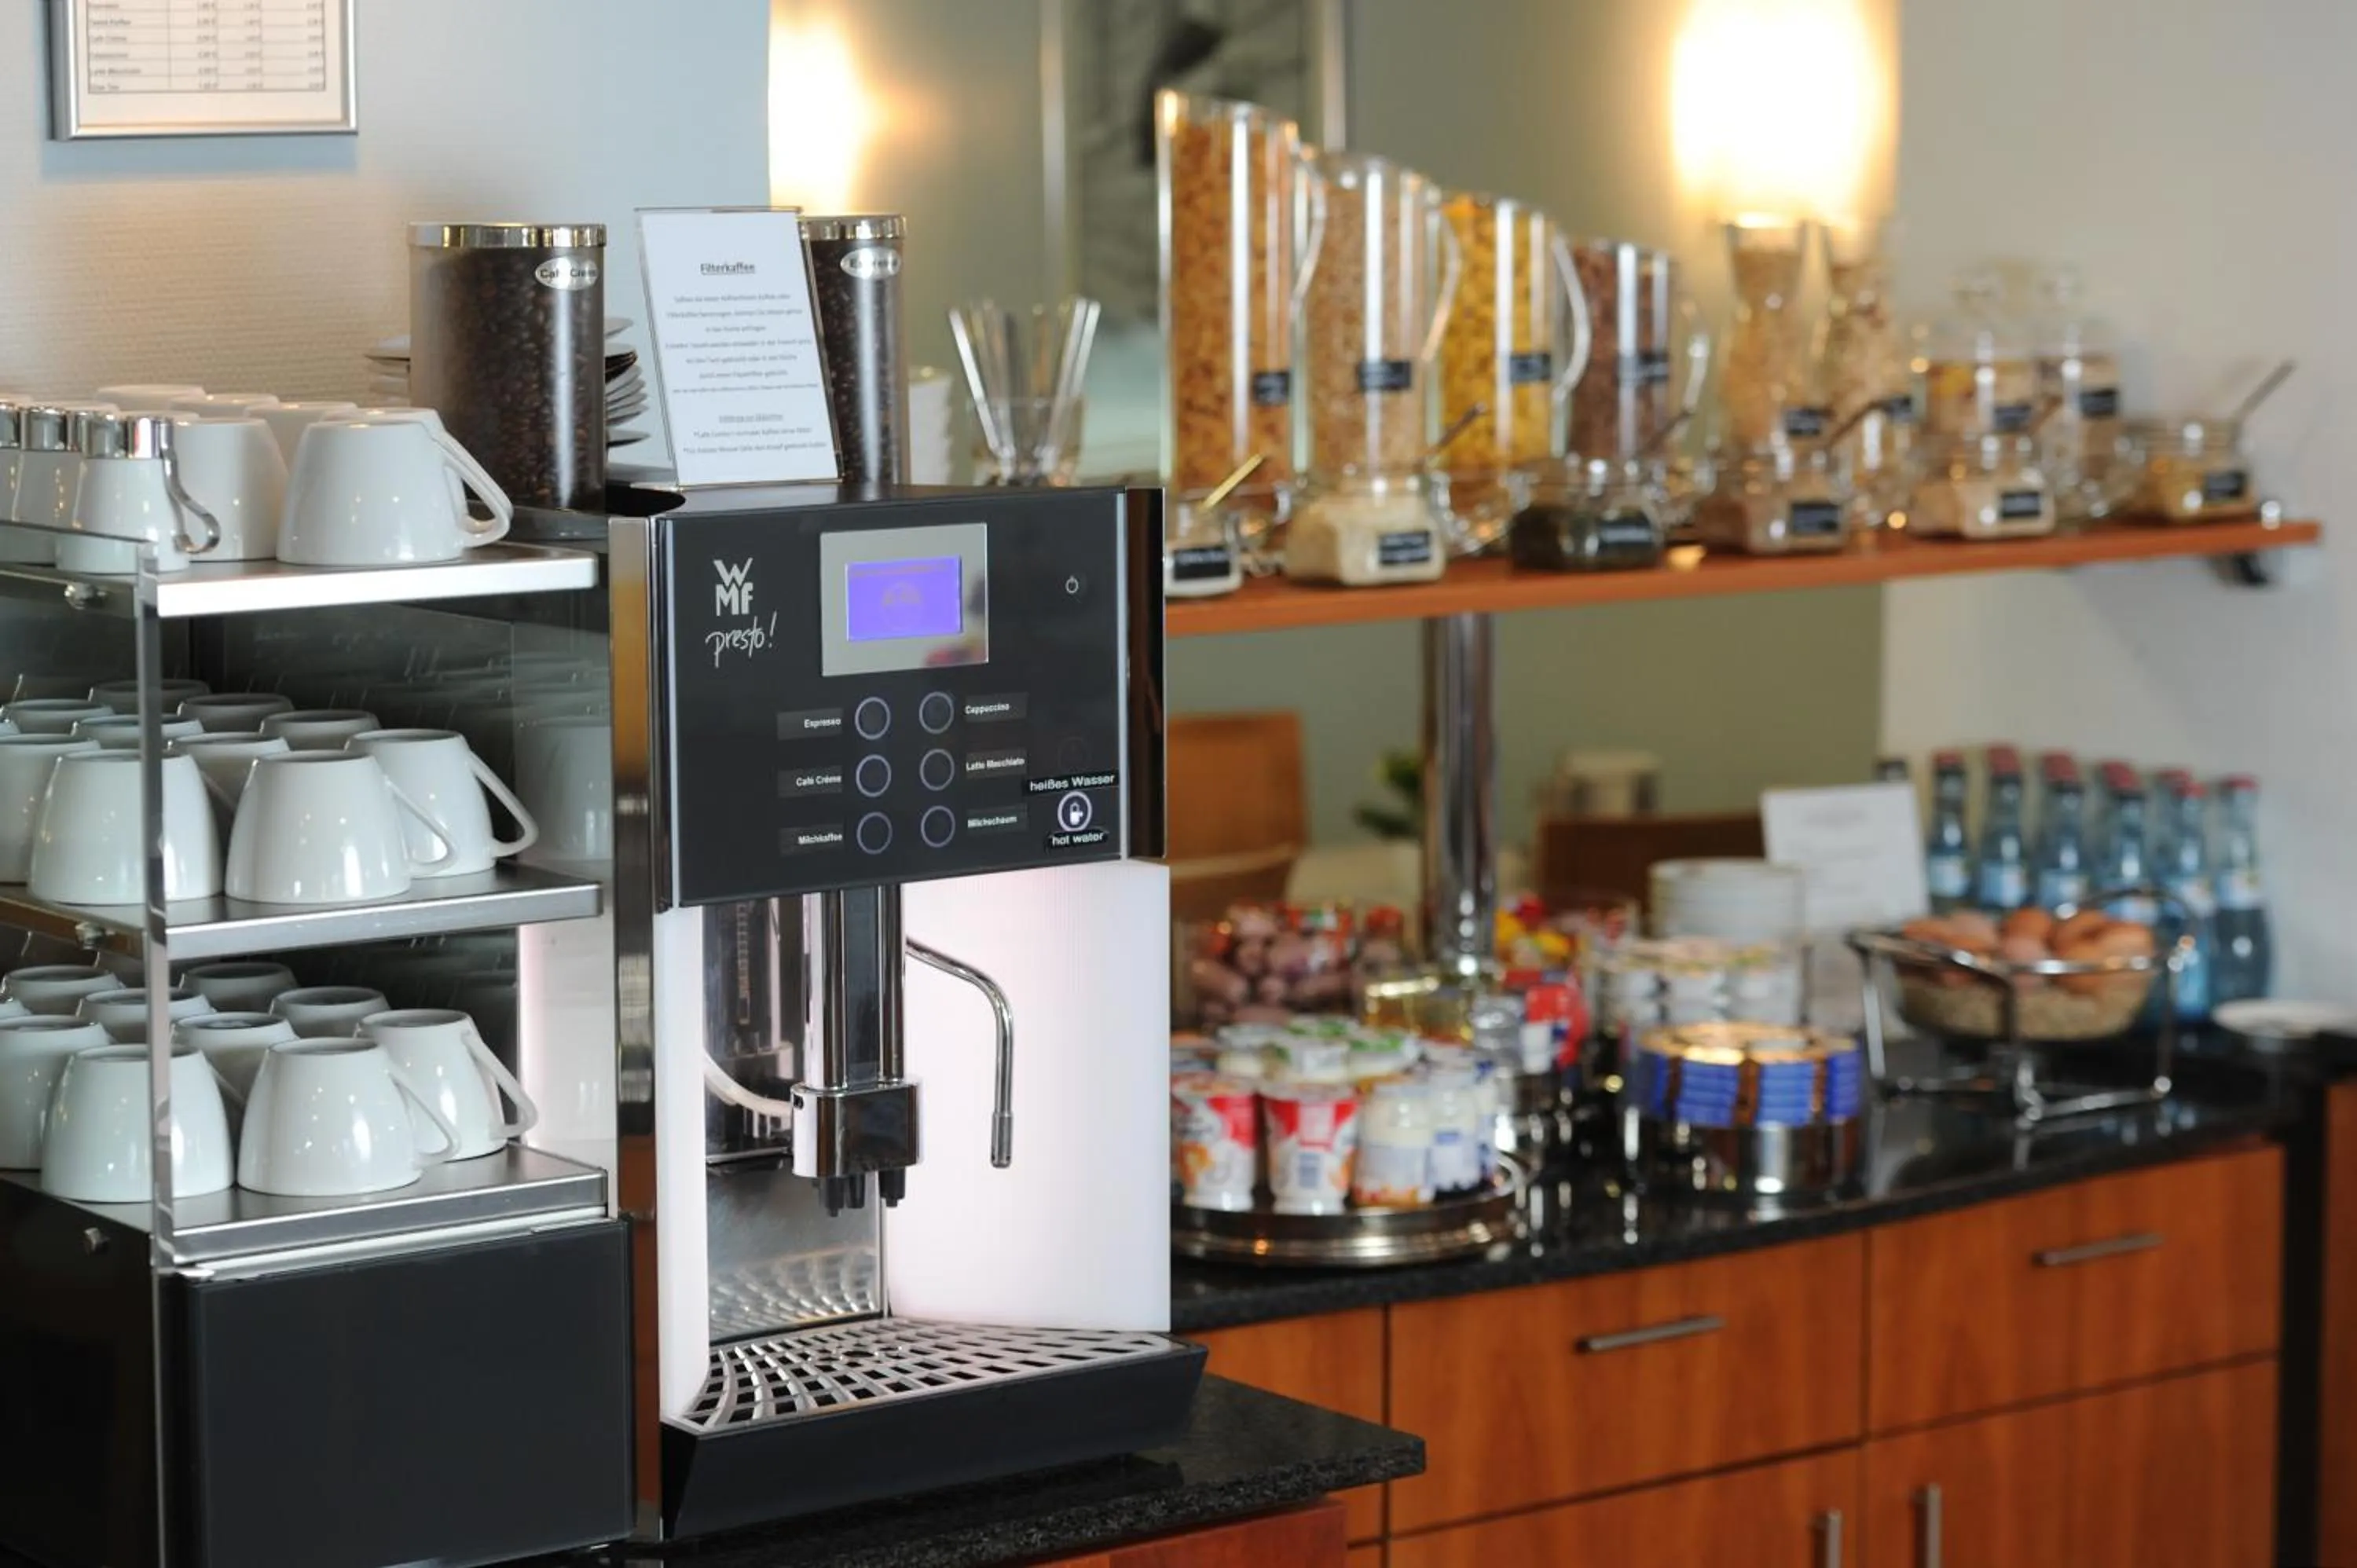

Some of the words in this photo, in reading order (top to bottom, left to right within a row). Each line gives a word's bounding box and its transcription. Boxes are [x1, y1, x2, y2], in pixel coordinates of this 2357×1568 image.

[713, 556, 754, 617] WMF
[705, 610, 778, 669] presto!
[965, 702, 1010, 715] Cappuccino
[804, 717, 841, 730] Espresso
[966, 760, 985, 772] Latte
[986, 757, 1025, 769] Macchiato
[1030, 779, 1069, 791] heißes
[1071, 775, 1115, 787] Wasser
[797, 832, 843, 845] Milchkaffee
[1052, 834, 1070, 846] hot
[1072, 832, 1104, 843] water
